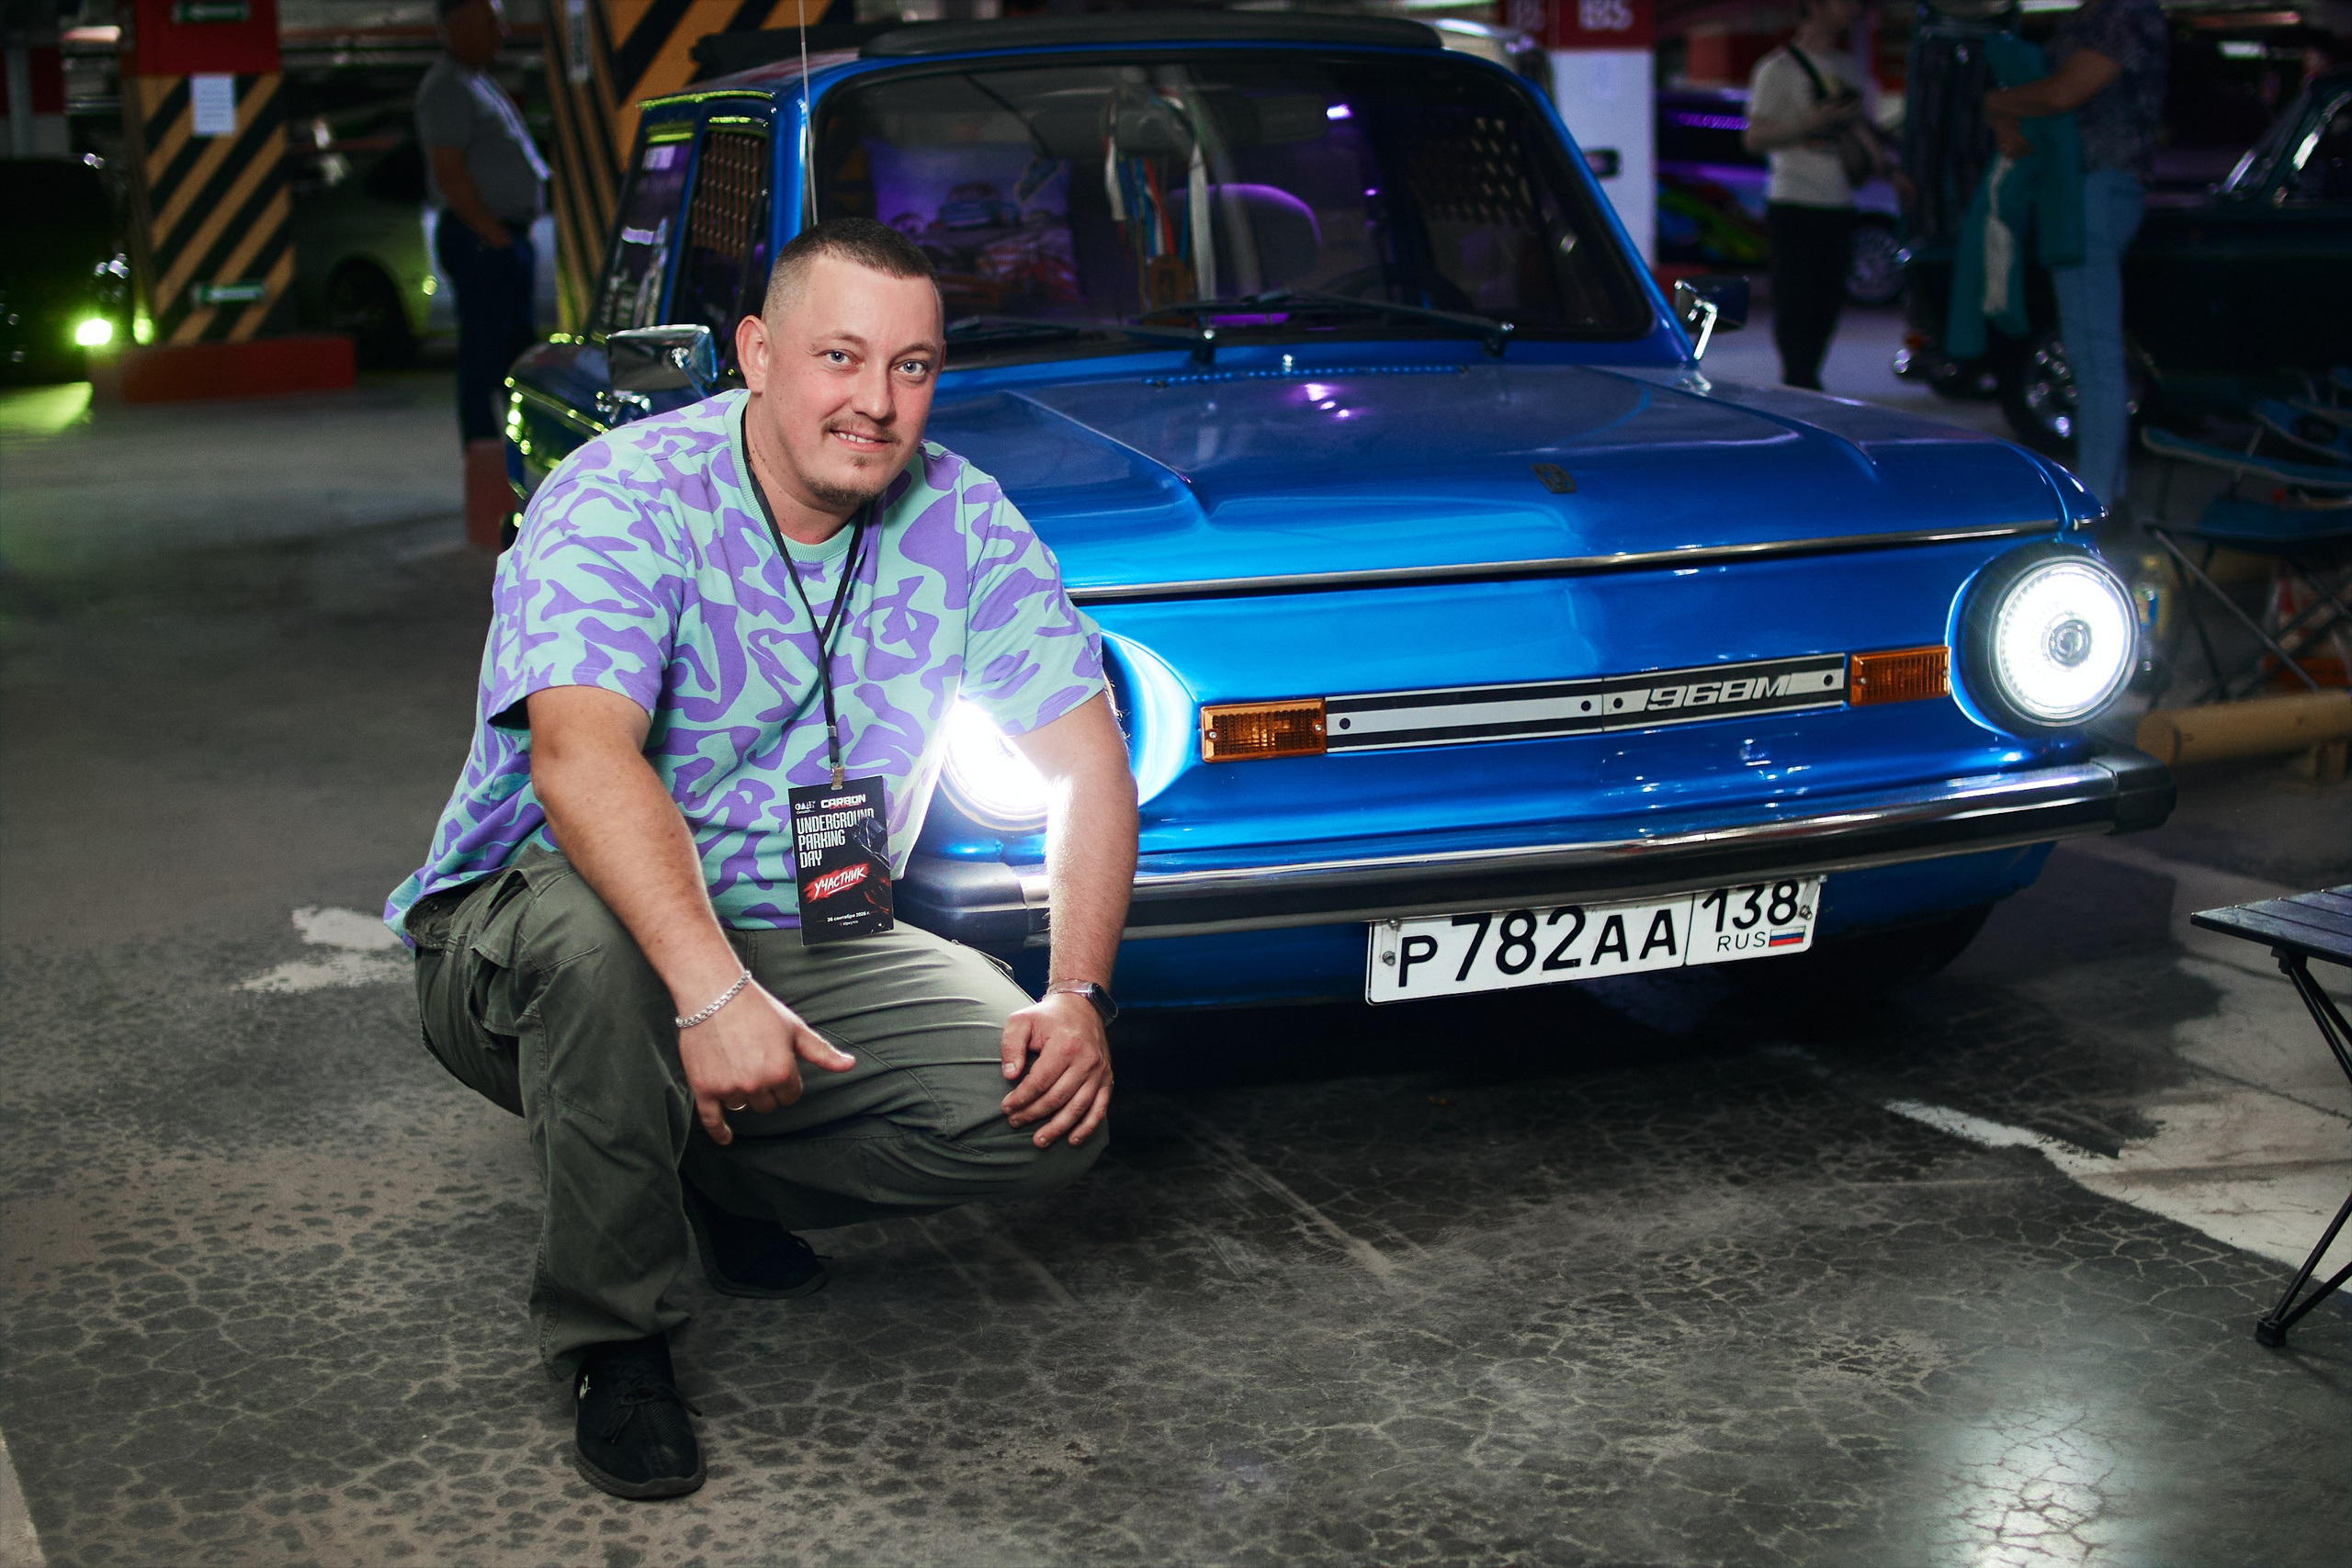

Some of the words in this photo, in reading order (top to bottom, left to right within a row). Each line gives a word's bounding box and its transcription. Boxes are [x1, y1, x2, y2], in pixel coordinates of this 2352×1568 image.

[1647, 674, 1791, 711] 968M
[820, 794, 866, 809] CARBON
[796, 807, 875, 835] UNDERGROUND
[797, 829, 846, 852] PARKING
[799, 849, 823, 869] DAY
[813, 866, 868, 901] УЧАСТНИК
[1702, 880, 1799, 932] 138
[1716, 931, 1766, 952] RUS
